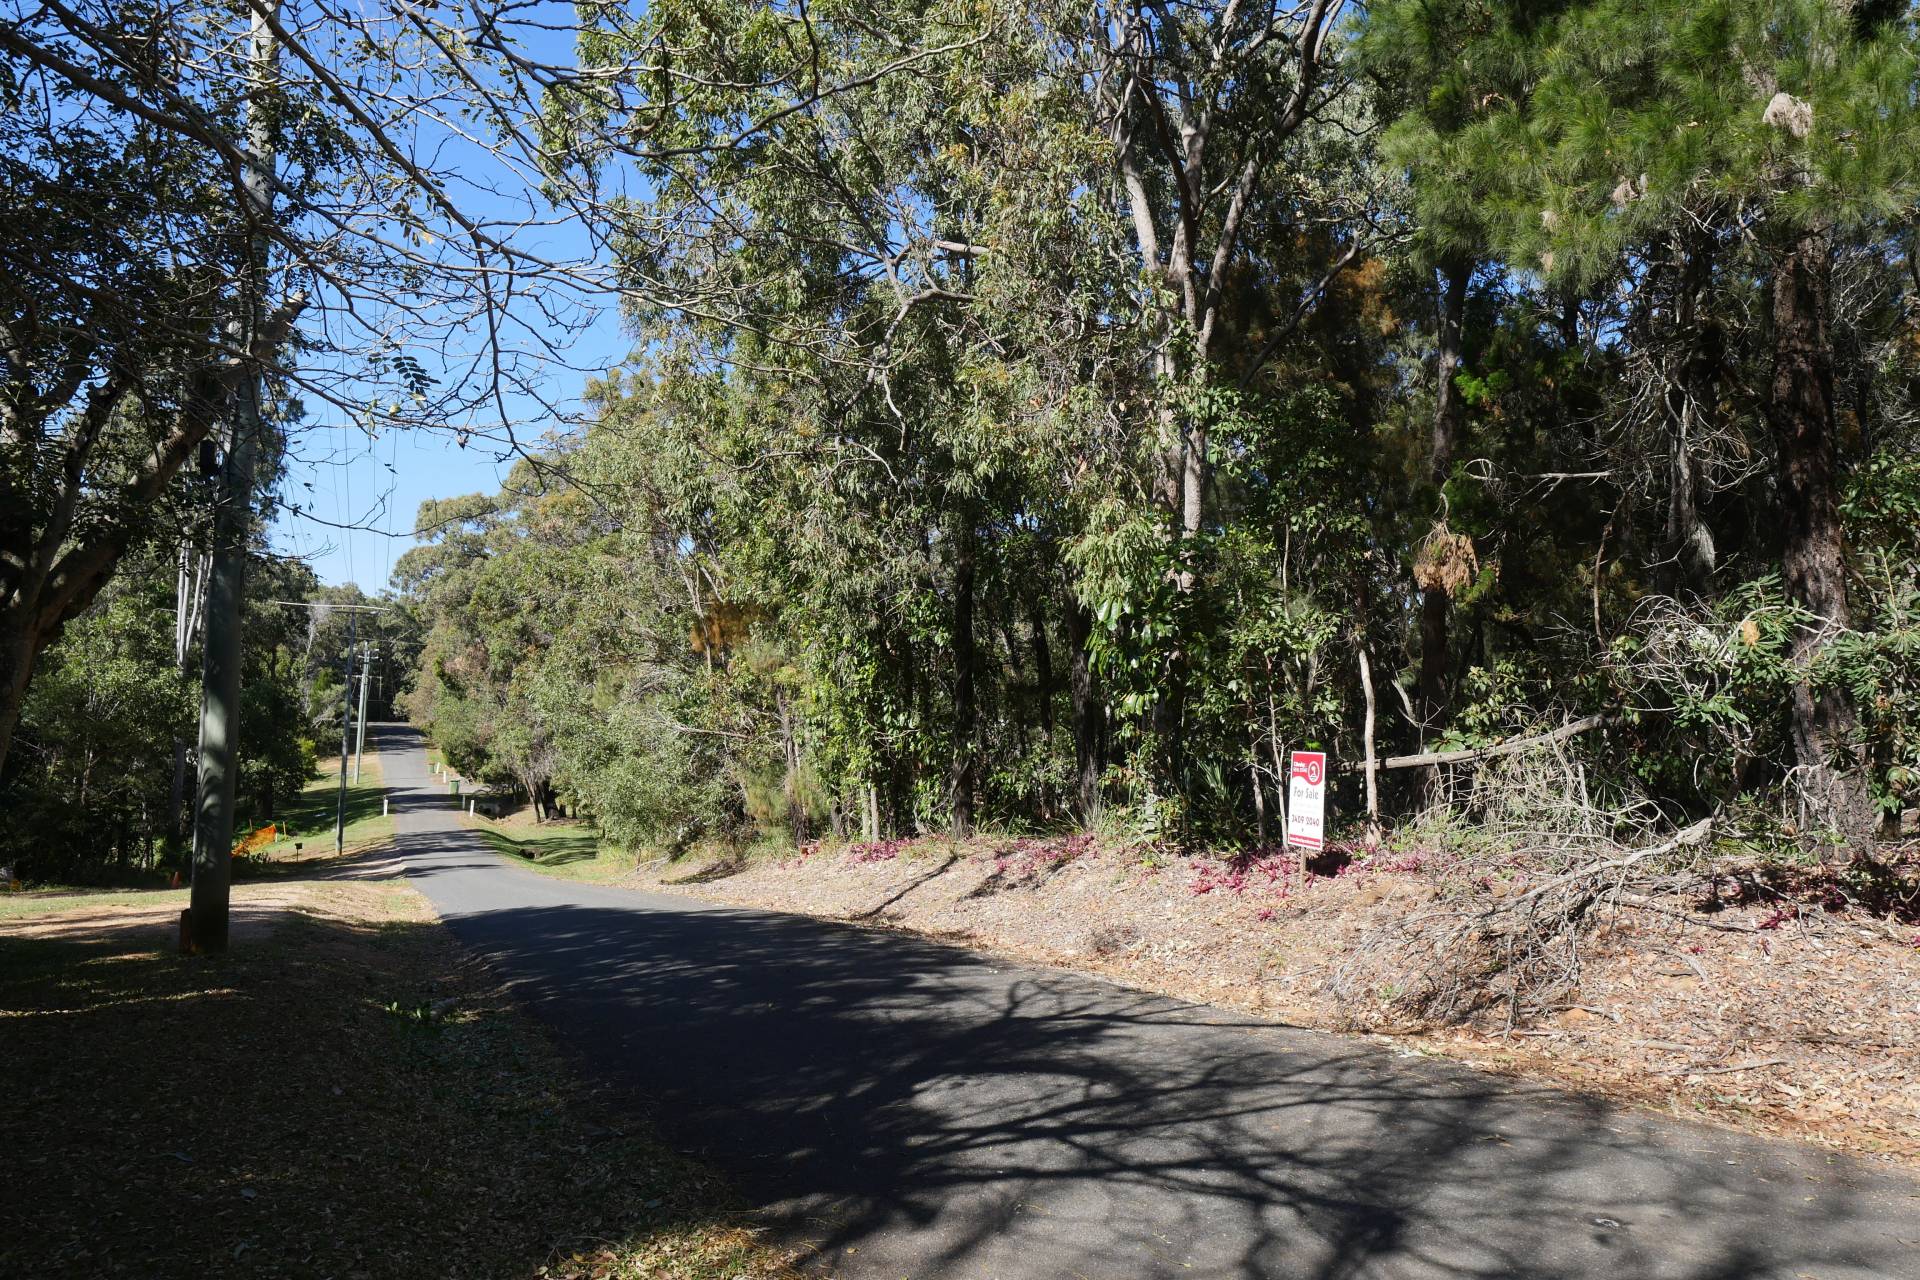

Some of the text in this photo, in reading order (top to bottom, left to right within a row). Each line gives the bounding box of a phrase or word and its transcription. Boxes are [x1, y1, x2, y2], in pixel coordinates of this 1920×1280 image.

[1293, 786, 1319, 800] For Sale
[1291, 813, 1304, 823] 3409
